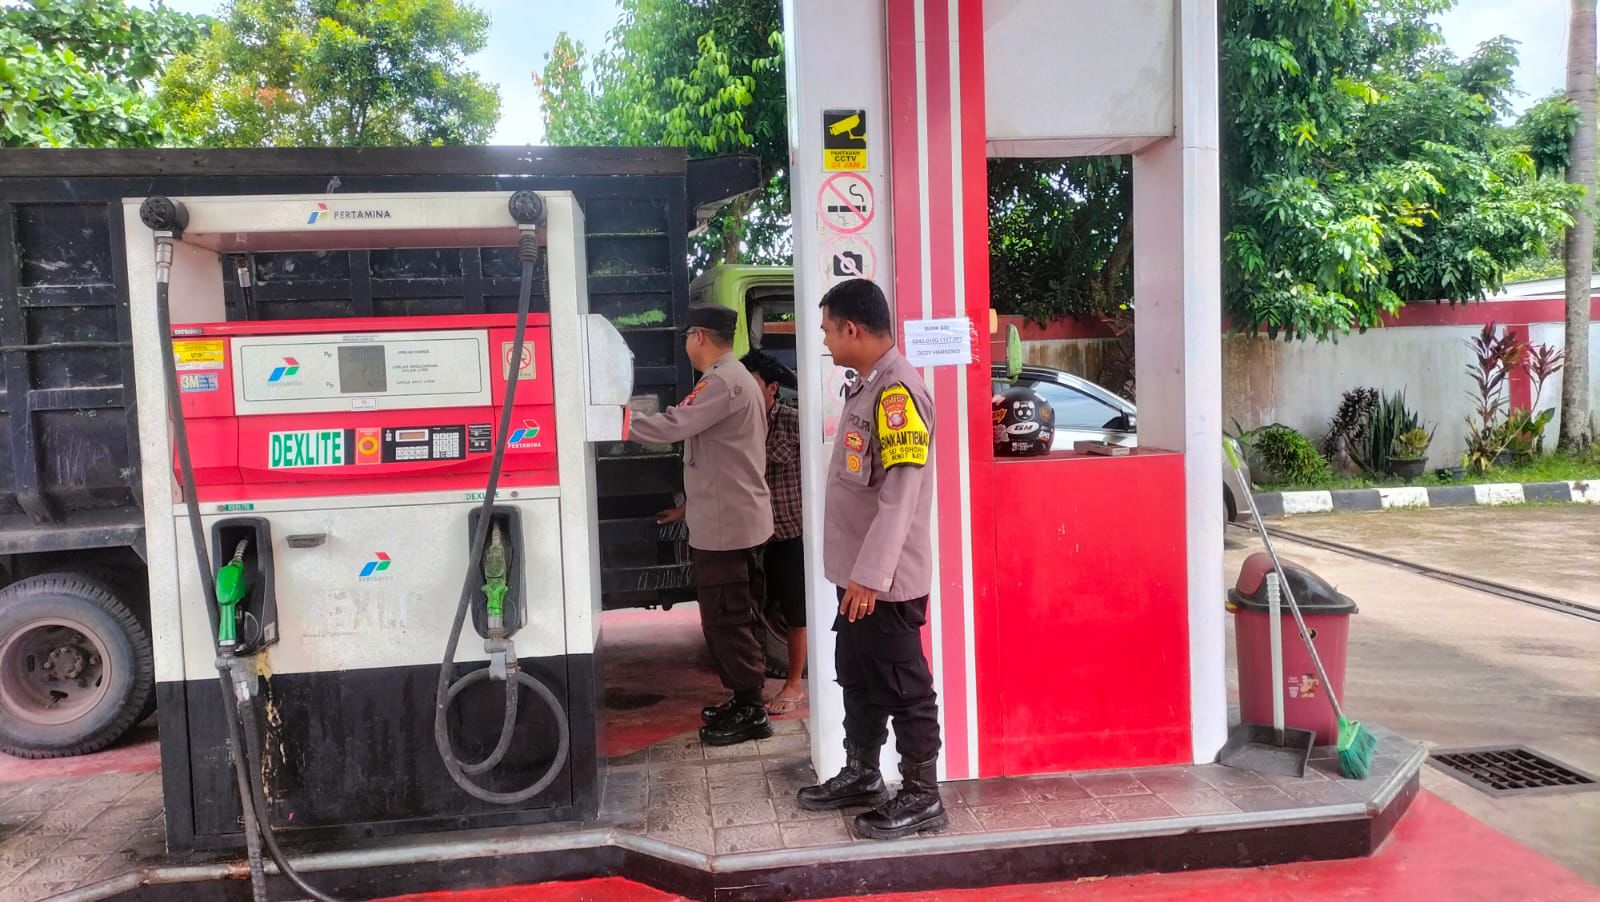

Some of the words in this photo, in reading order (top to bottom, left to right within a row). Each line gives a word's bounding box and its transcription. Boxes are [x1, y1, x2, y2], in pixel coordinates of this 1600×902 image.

[334, 209, 391, 219] PERTAMINA
[182, 374, 199, 389] 3M
[271, 431, 342, 468] DEXLITE
